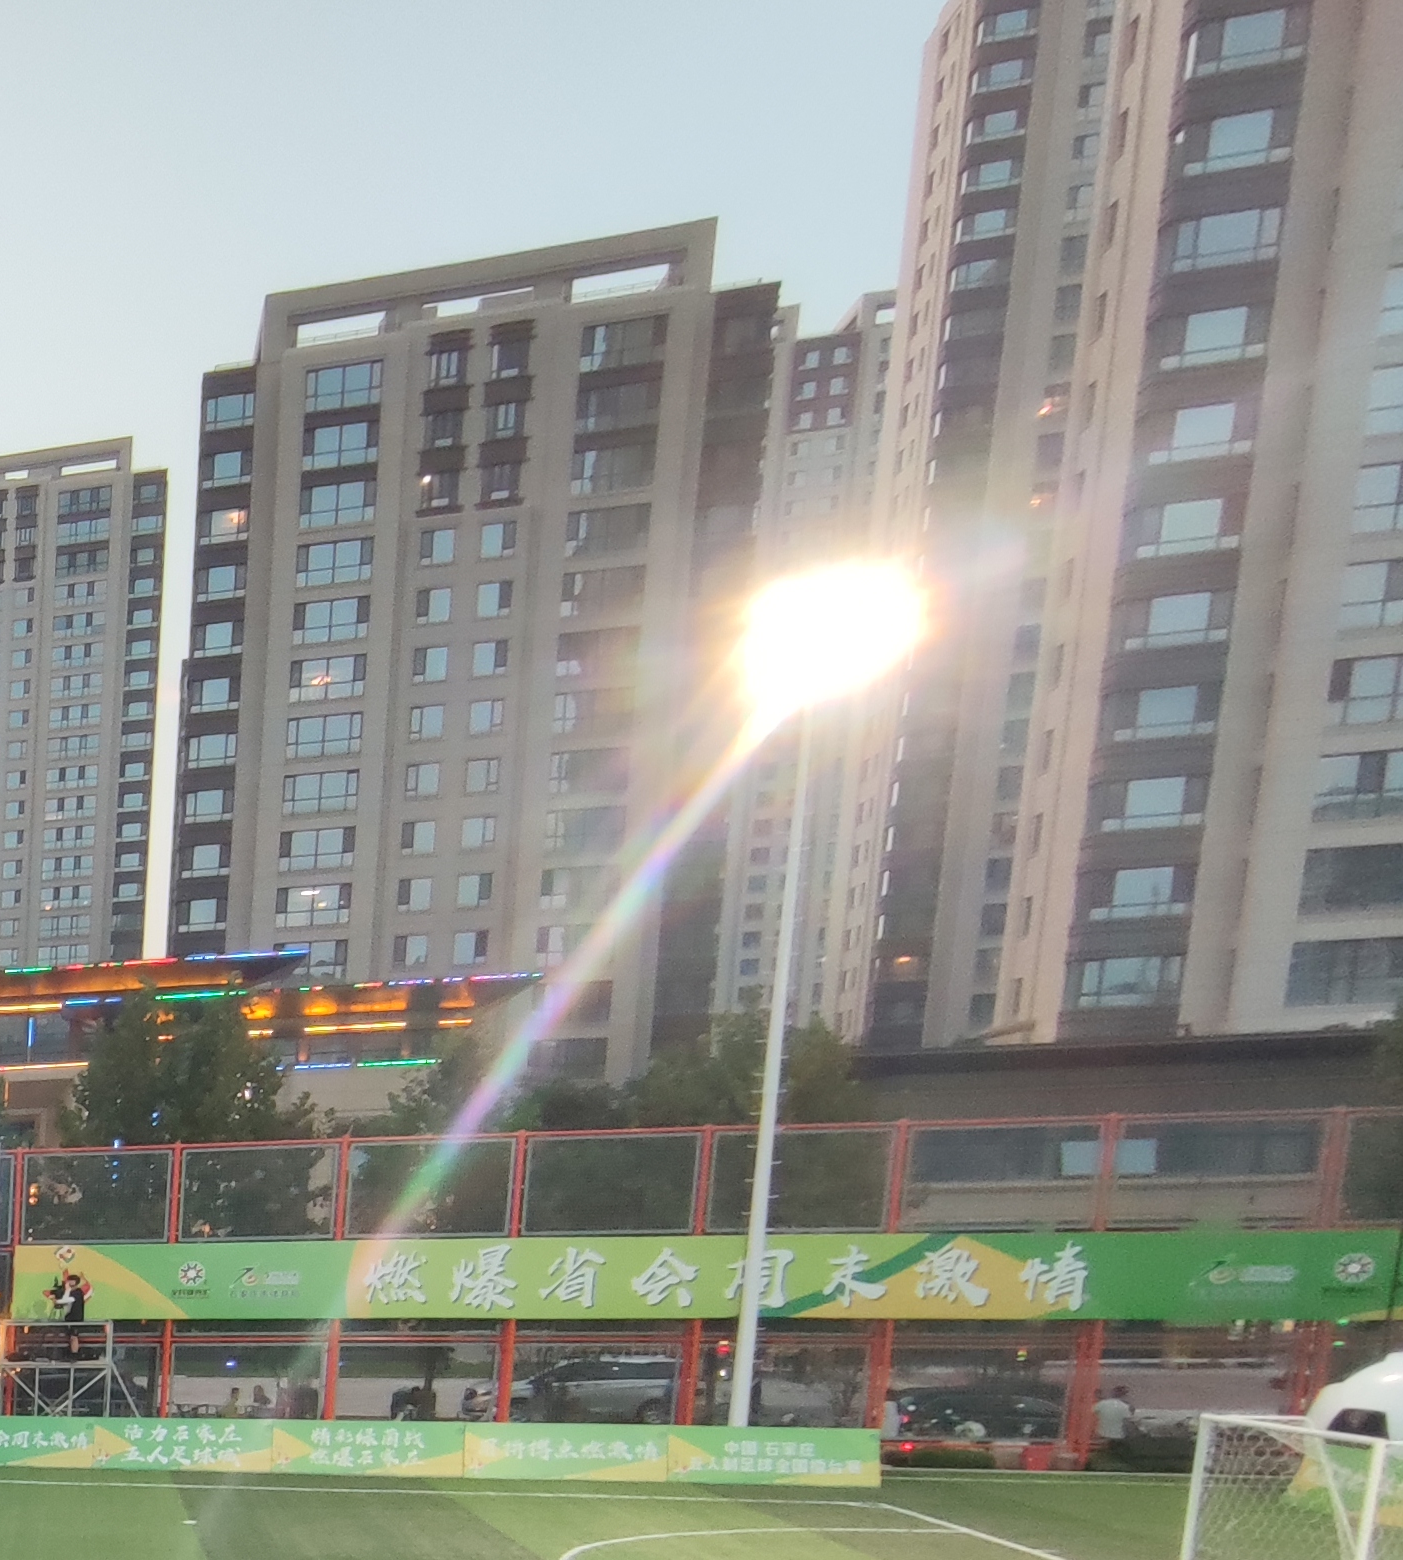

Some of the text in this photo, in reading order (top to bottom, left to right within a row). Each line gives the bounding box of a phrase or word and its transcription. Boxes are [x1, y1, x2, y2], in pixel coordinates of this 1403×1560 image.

[364, 1241, 1090, 1312] 燃爆省会周末激情
